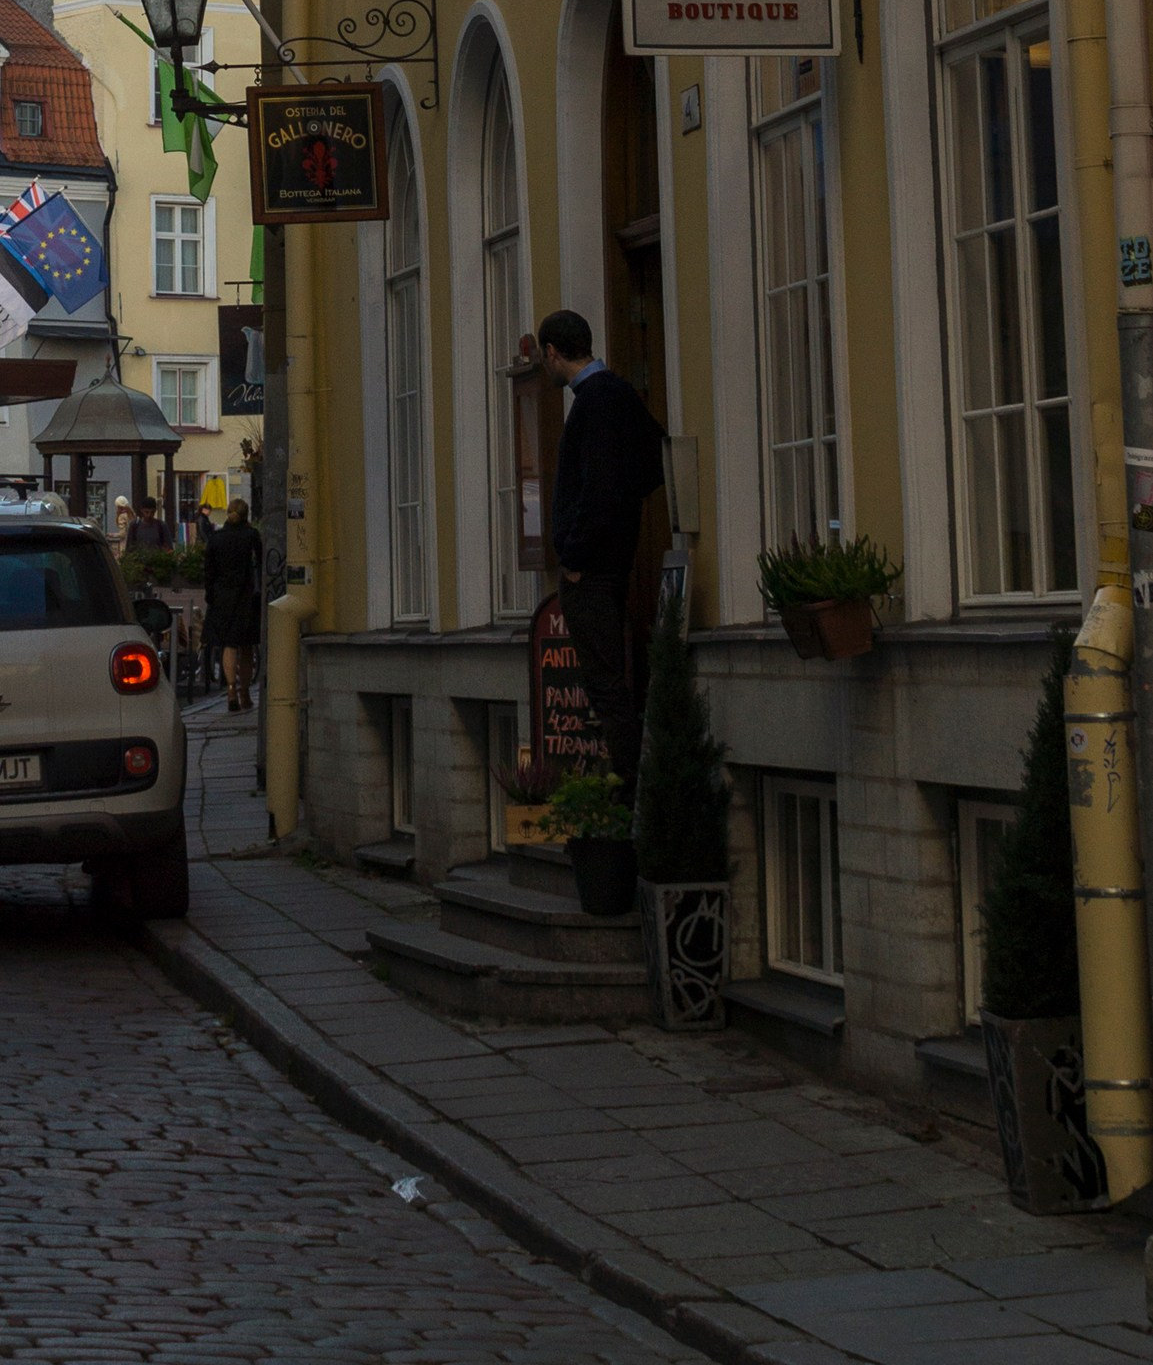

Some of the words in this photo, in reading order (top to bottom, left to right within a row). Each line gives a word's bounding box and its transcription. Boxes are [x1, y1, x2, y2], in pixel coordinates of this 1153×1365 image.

[667, 2, 799, 22] BOUTIQUE
[285, 107, 326, 118] OSTERIA
[329, 105, 347, 116] DEL
[542, 646, 581, 669] ANTI
[545, 684, 590, 709] PANIN
[544, 734, 609, 759] TIRAMIS
